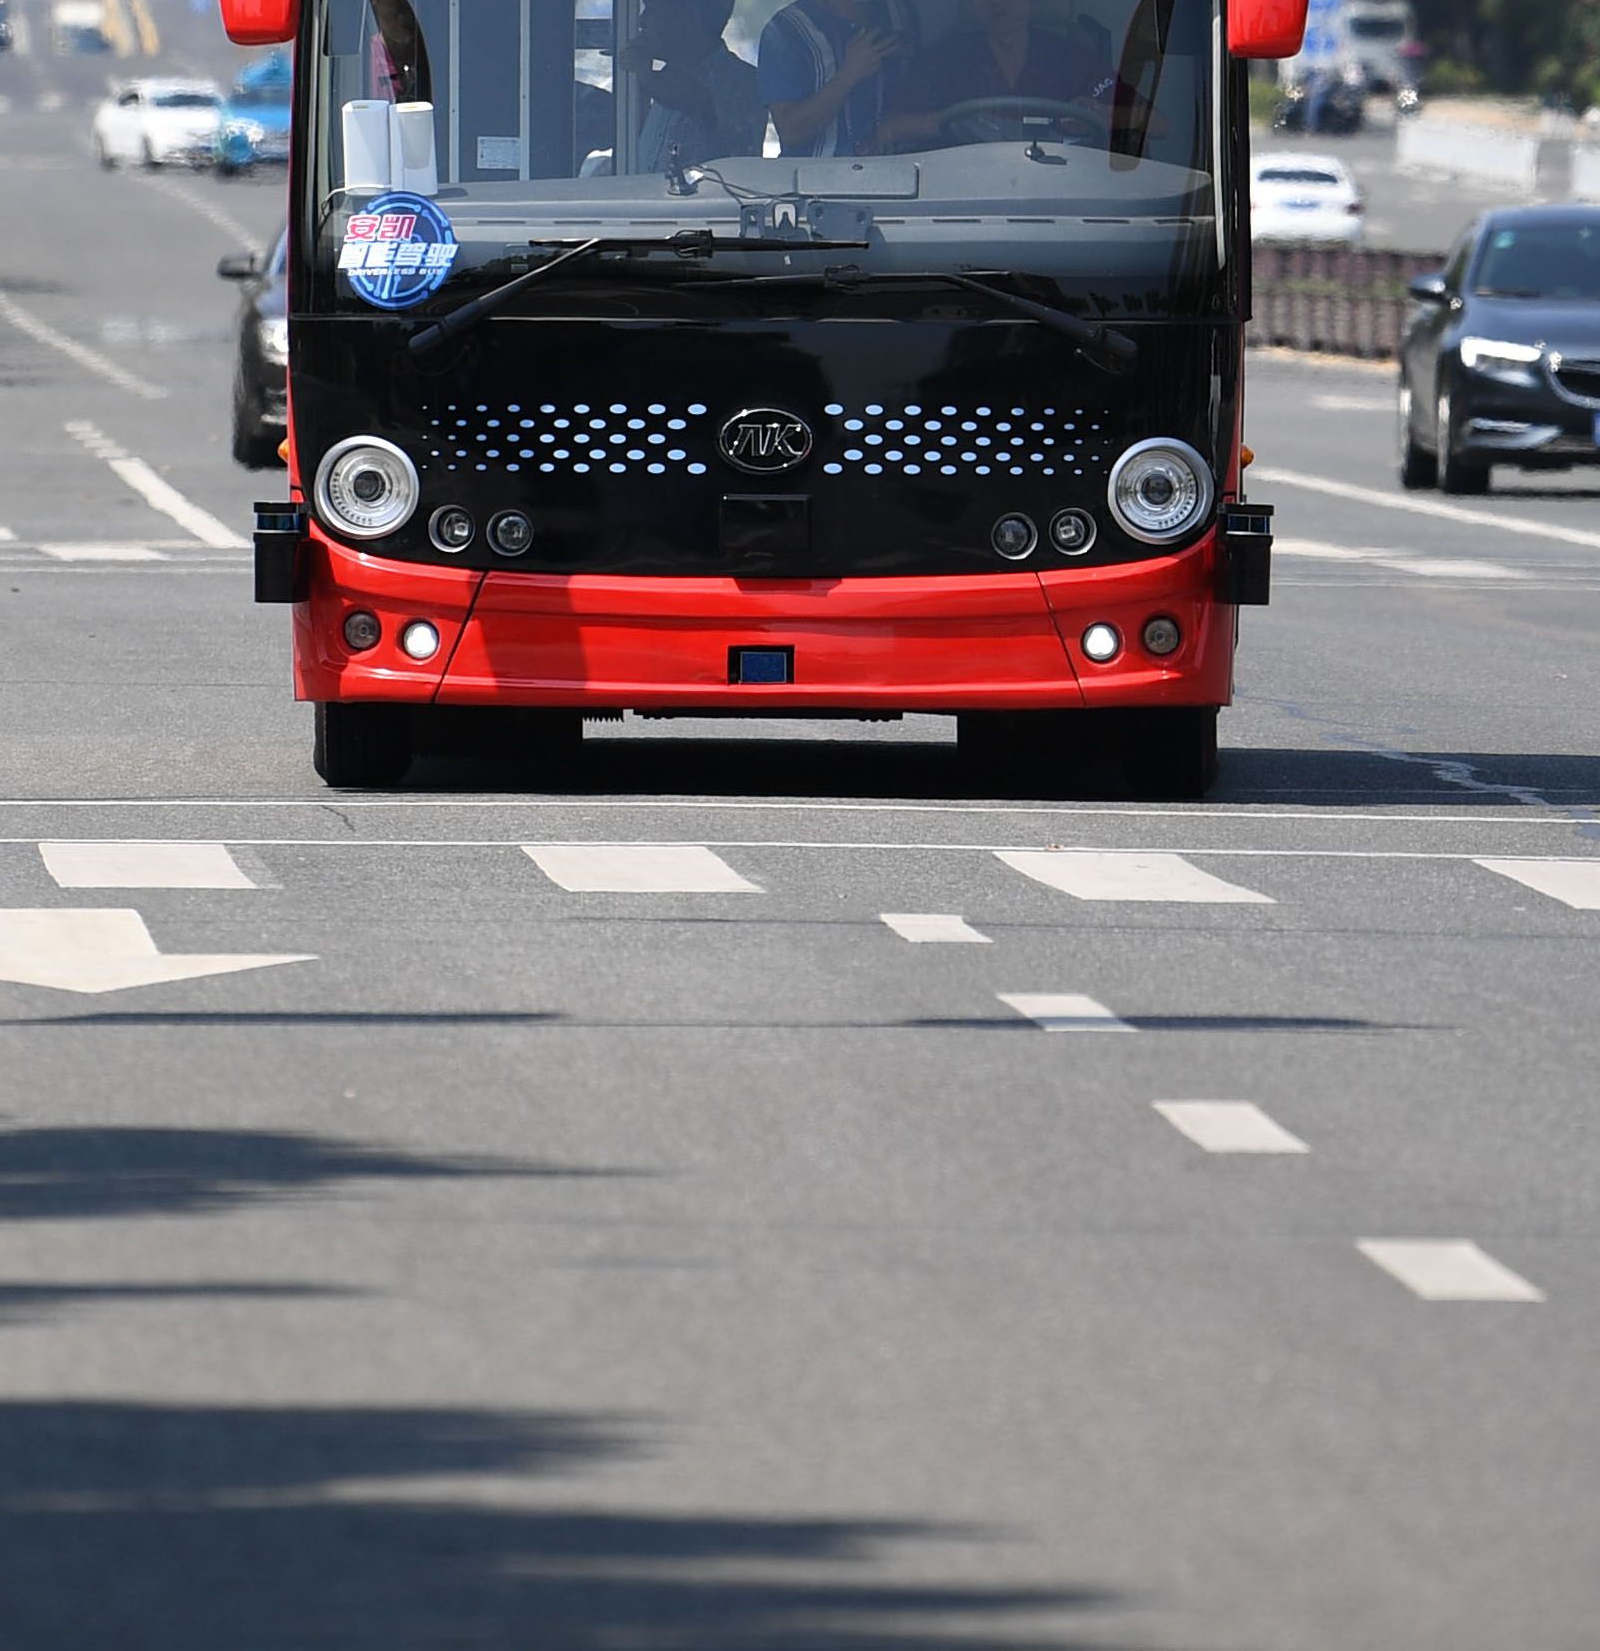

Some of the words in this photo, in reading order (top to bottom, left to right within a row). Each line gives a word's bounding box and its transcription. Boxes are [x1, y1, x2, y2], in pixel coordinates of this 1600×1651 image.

[344, 214, 417, 242] 安凯
[338, 242, 459, 269] 智能驾驶
